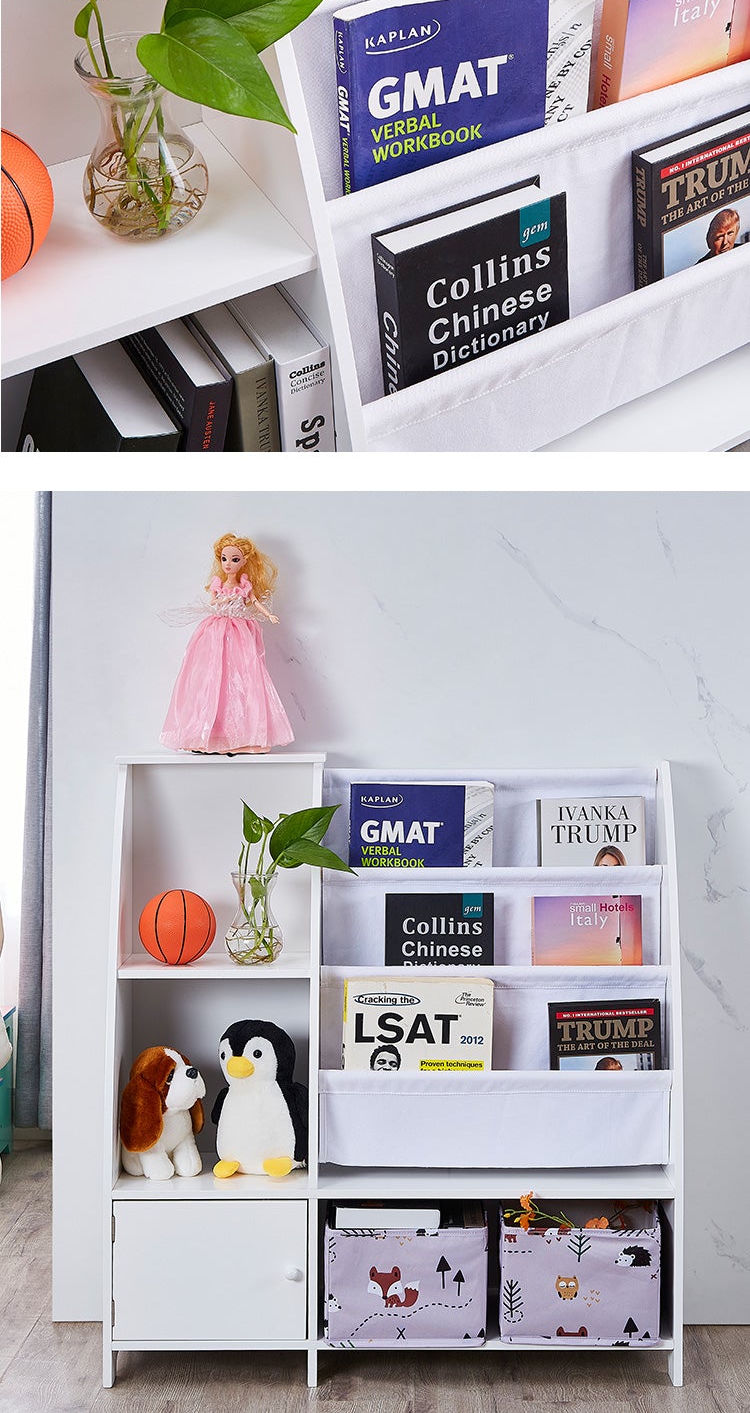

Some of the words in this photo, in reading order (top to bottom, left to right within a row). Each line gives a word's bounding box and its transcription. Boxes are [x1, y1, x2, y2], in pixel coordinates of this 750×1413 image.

[365, 24, 431, 49] KAPLAN
[337, 31, 345, 70] KAPLAN
[603, 34, 613, 70] small
[557, 60, 575, 77] BY
[368, 54, 508, 119] GMAT
[337, 85, 350, 131] GMAT
[371, 112, 442, 143] VERBAL
[372, 123, 483, 164] WORKBOOK
[685, 143, 734, 167] INTERNATIONAL
[635, 167, 647, 227] TRUMP
[661, 207, 684, 226] THE
[686, 196, 709, 214] ART
[710, 189, 725, 202] OF
[727, 178, 749, 195] THE
[522, 219, 548, 243] gem
[426, 246, 551, 309] Collins
[428, 283, 552, 344] Chinese
[433, 311, 550, 371] Dictionary
[289, 360, 326, 379] Collins
[290, 370, 325, 387] Concise
[291, 377, 326, 394] Dictionary
[361, 795, 398, 803] KAPLAN
[558, 805, 629, 821] IVANKA
[360, 820, 441, 844] GMAT
[551, 824, 637, 843] TRUMP
[361, 846, 402, 856] VERBAL
[361, 857, 425, 867] WORKBOOK
[463, 906, 481, 916] gem
[569, 903, 596, 912] small
[600, 903, 634, 912] Hotels
[402, 917, 482, 935] Collins
[570, 913, 608, 929] Italy
[401, 941, 482, 957] Chinese
[358, 995, 397, 1005] Cracking
[400, 996, 414, 1004] the
[355, 1012, 458, 1044] LSAT
[557, 1018, 654, 1041] TRUMP
[460, 1036, 484, 1044] 2012
[577, 1043, 596, 1051] ART
[597, 1042, 608, 1050] OF
[610, 1041, 629, 1049] THE
[631, 1040, 654, 1048] DEAL
